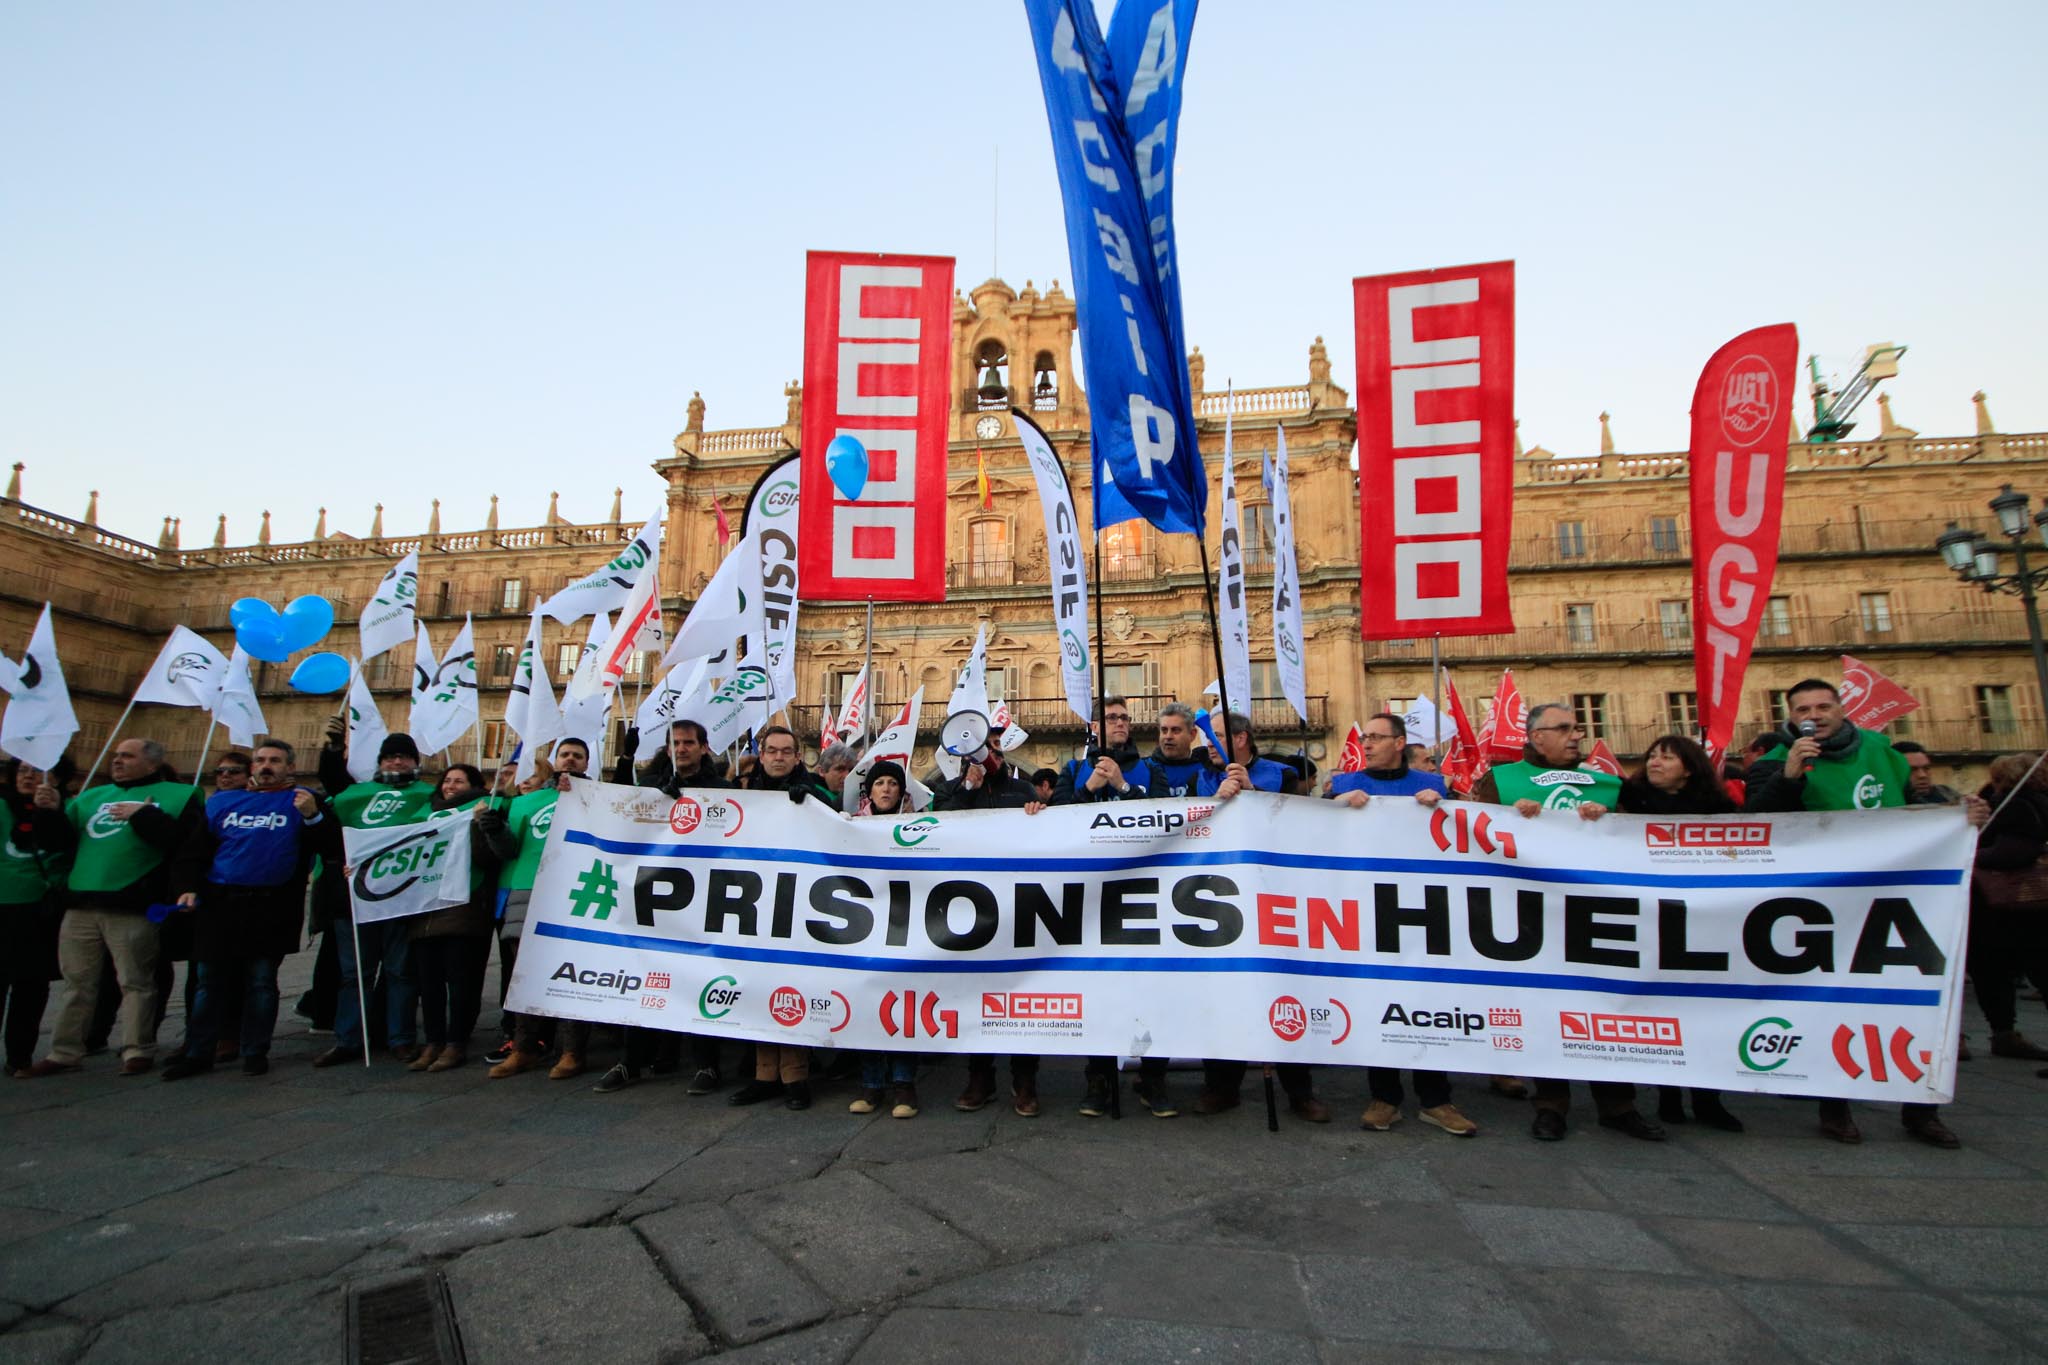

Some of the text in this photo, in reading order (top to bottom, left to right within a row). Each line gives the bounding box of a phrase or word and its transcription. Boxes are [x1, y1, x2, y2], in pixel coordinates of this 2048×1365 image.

[1727, 371, 1769, 405] UGT
[832, 264, 921, 579] CCOO
[1388, 278, 1482, 620] CCOO
[760, 528, 797, 630] CSIF
[1706, 452, 1769, 708] UGT
[672, 803, 697, 820] UGT
[222, 812, 287, 831] Acaip
[1090, 810, 1184, 832] Acaip
[1430, 807, 1517, 859] CIG
[1684, 827, 1766, 842] CCOO
[1649, 848, 1693, 856] servicios
[550, 962, 642, 995] Acaip
[647, 978, 668, 988] EPSU
[707, 989, 741, 1006] CSIF
[773, 992, 801, 1010] UGT
[811, 998, 831, 1011] ESP
[1014, 997, 1078, 1014] CCOO
[879, 990, 958, 1038] CIG
[1274, 1003, 1302, 1021] UGT
[1310, 1008, 1330, 1021] ESP
[1381, 1003, 1485, 1036] Acaip
[1491, 1015, 1519, 1025] EPSU
[981, 1020, 1018, 1028] servicios
[1027, 1020, 1035, 1028] la
[1597, 1019, 1677, 1041] CCOO
[1562, 1041, 1607, 1052] servicios
[1617, 1044, 1626, 1053] la
[1750, 1034, 1802, 1055] CSIF
